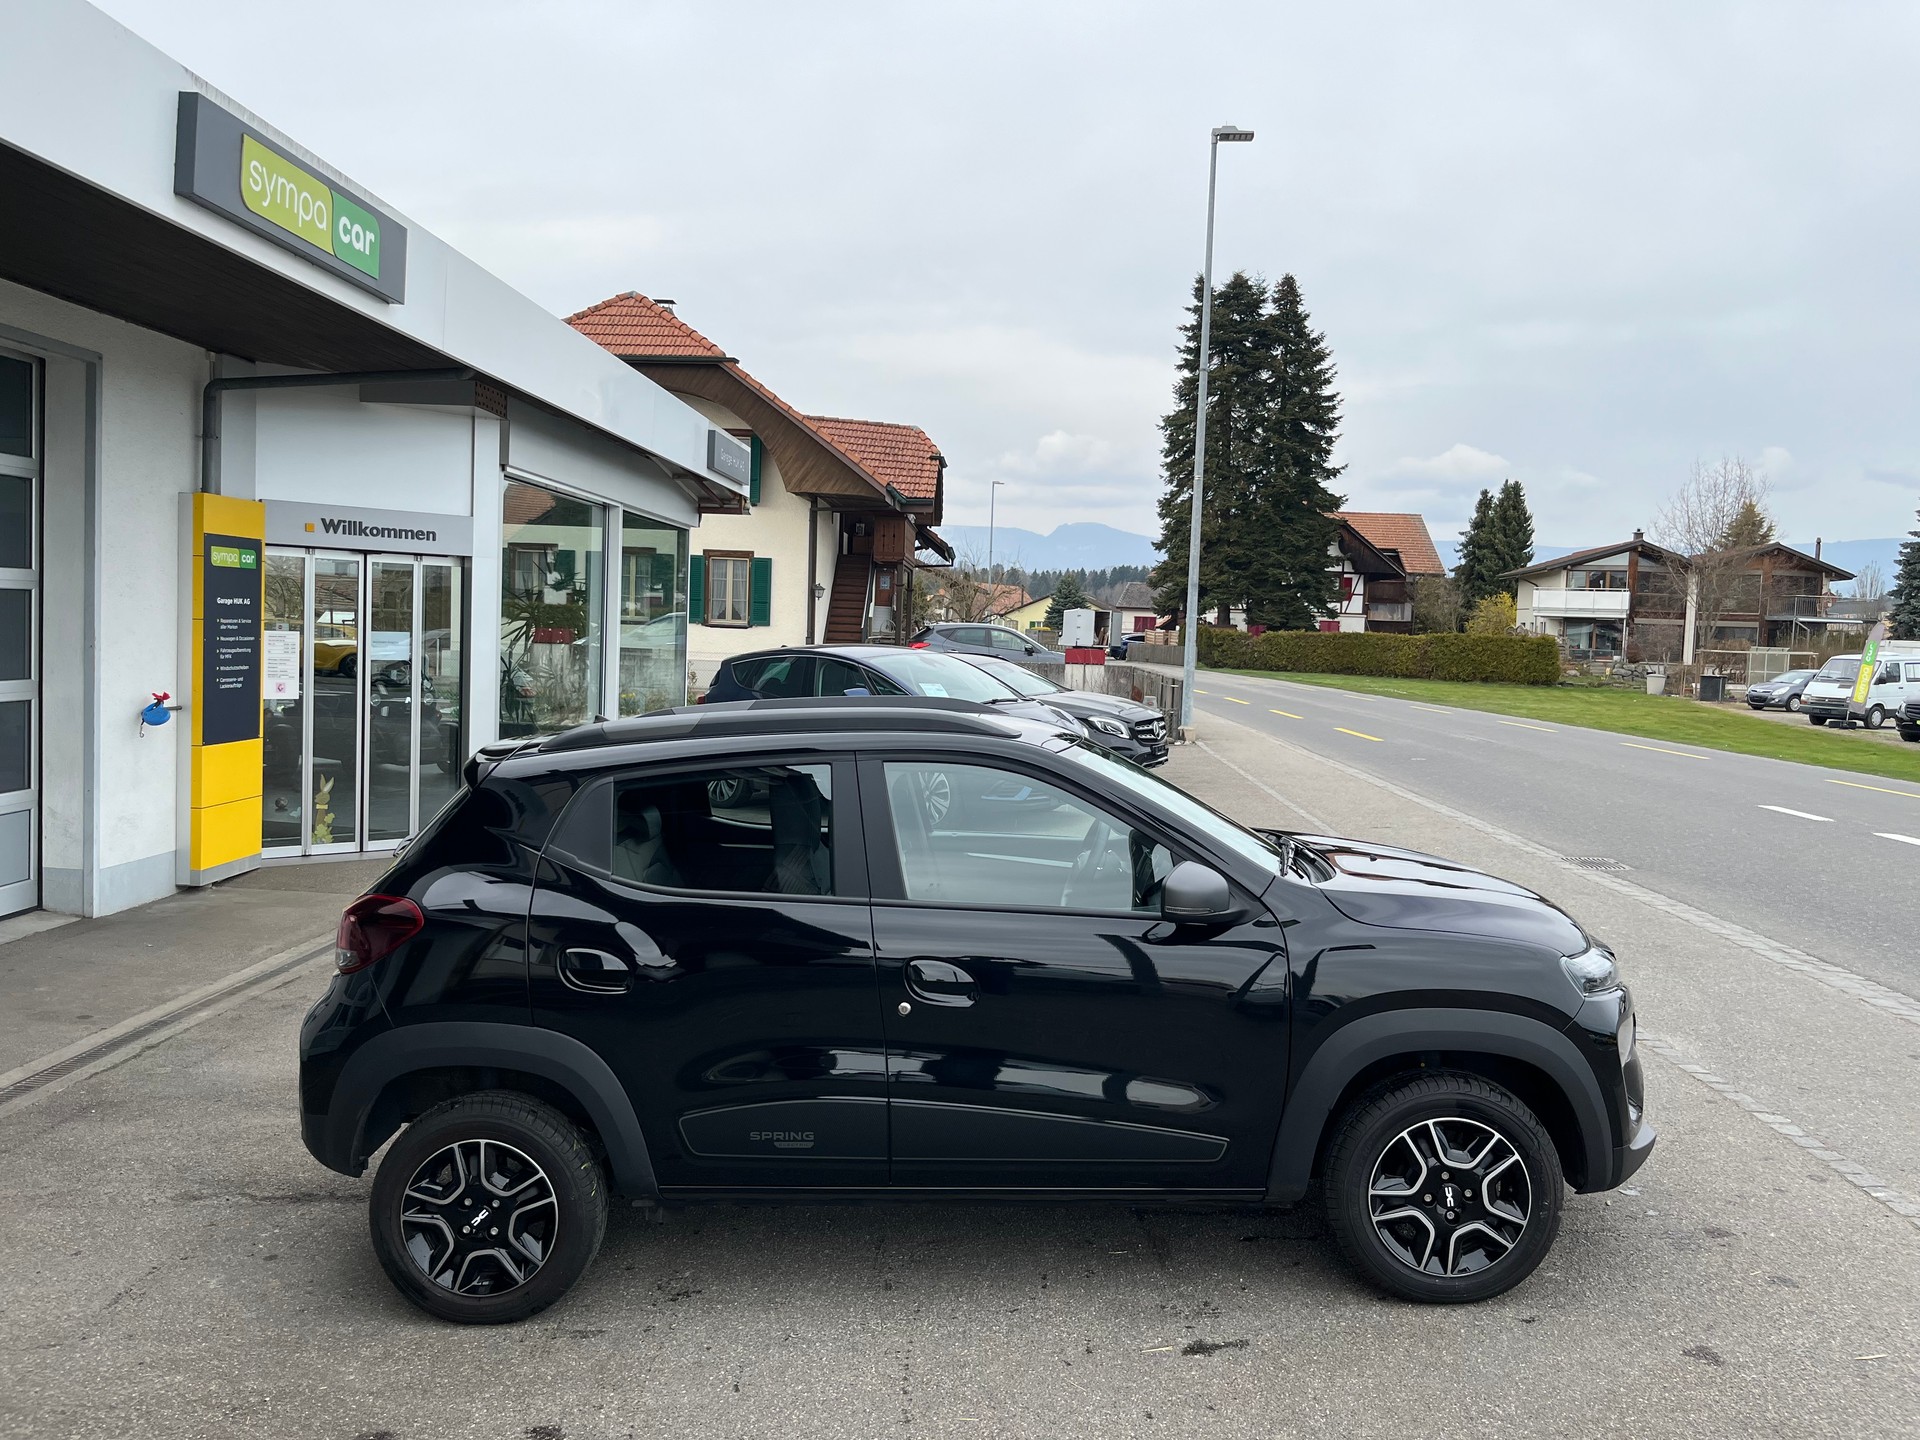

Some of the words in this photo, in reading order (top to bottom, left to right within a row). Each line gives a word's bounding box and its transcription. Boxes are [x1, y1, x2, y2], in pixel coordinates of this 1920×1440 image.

[249, 160, 327, 231] sympa
[339, 216, 375, 256] car
[320, 518, 437, 542] Willkommen
[213, 551, 238, 564] sympa
[241, 554, 255, 563] car
[216, 597, 233, 605] Garage
[1865, 644, 1874, 662] car
[1857, 667, 1870, 700] sympa
[750, 1131, 815, 1141] SPRING
